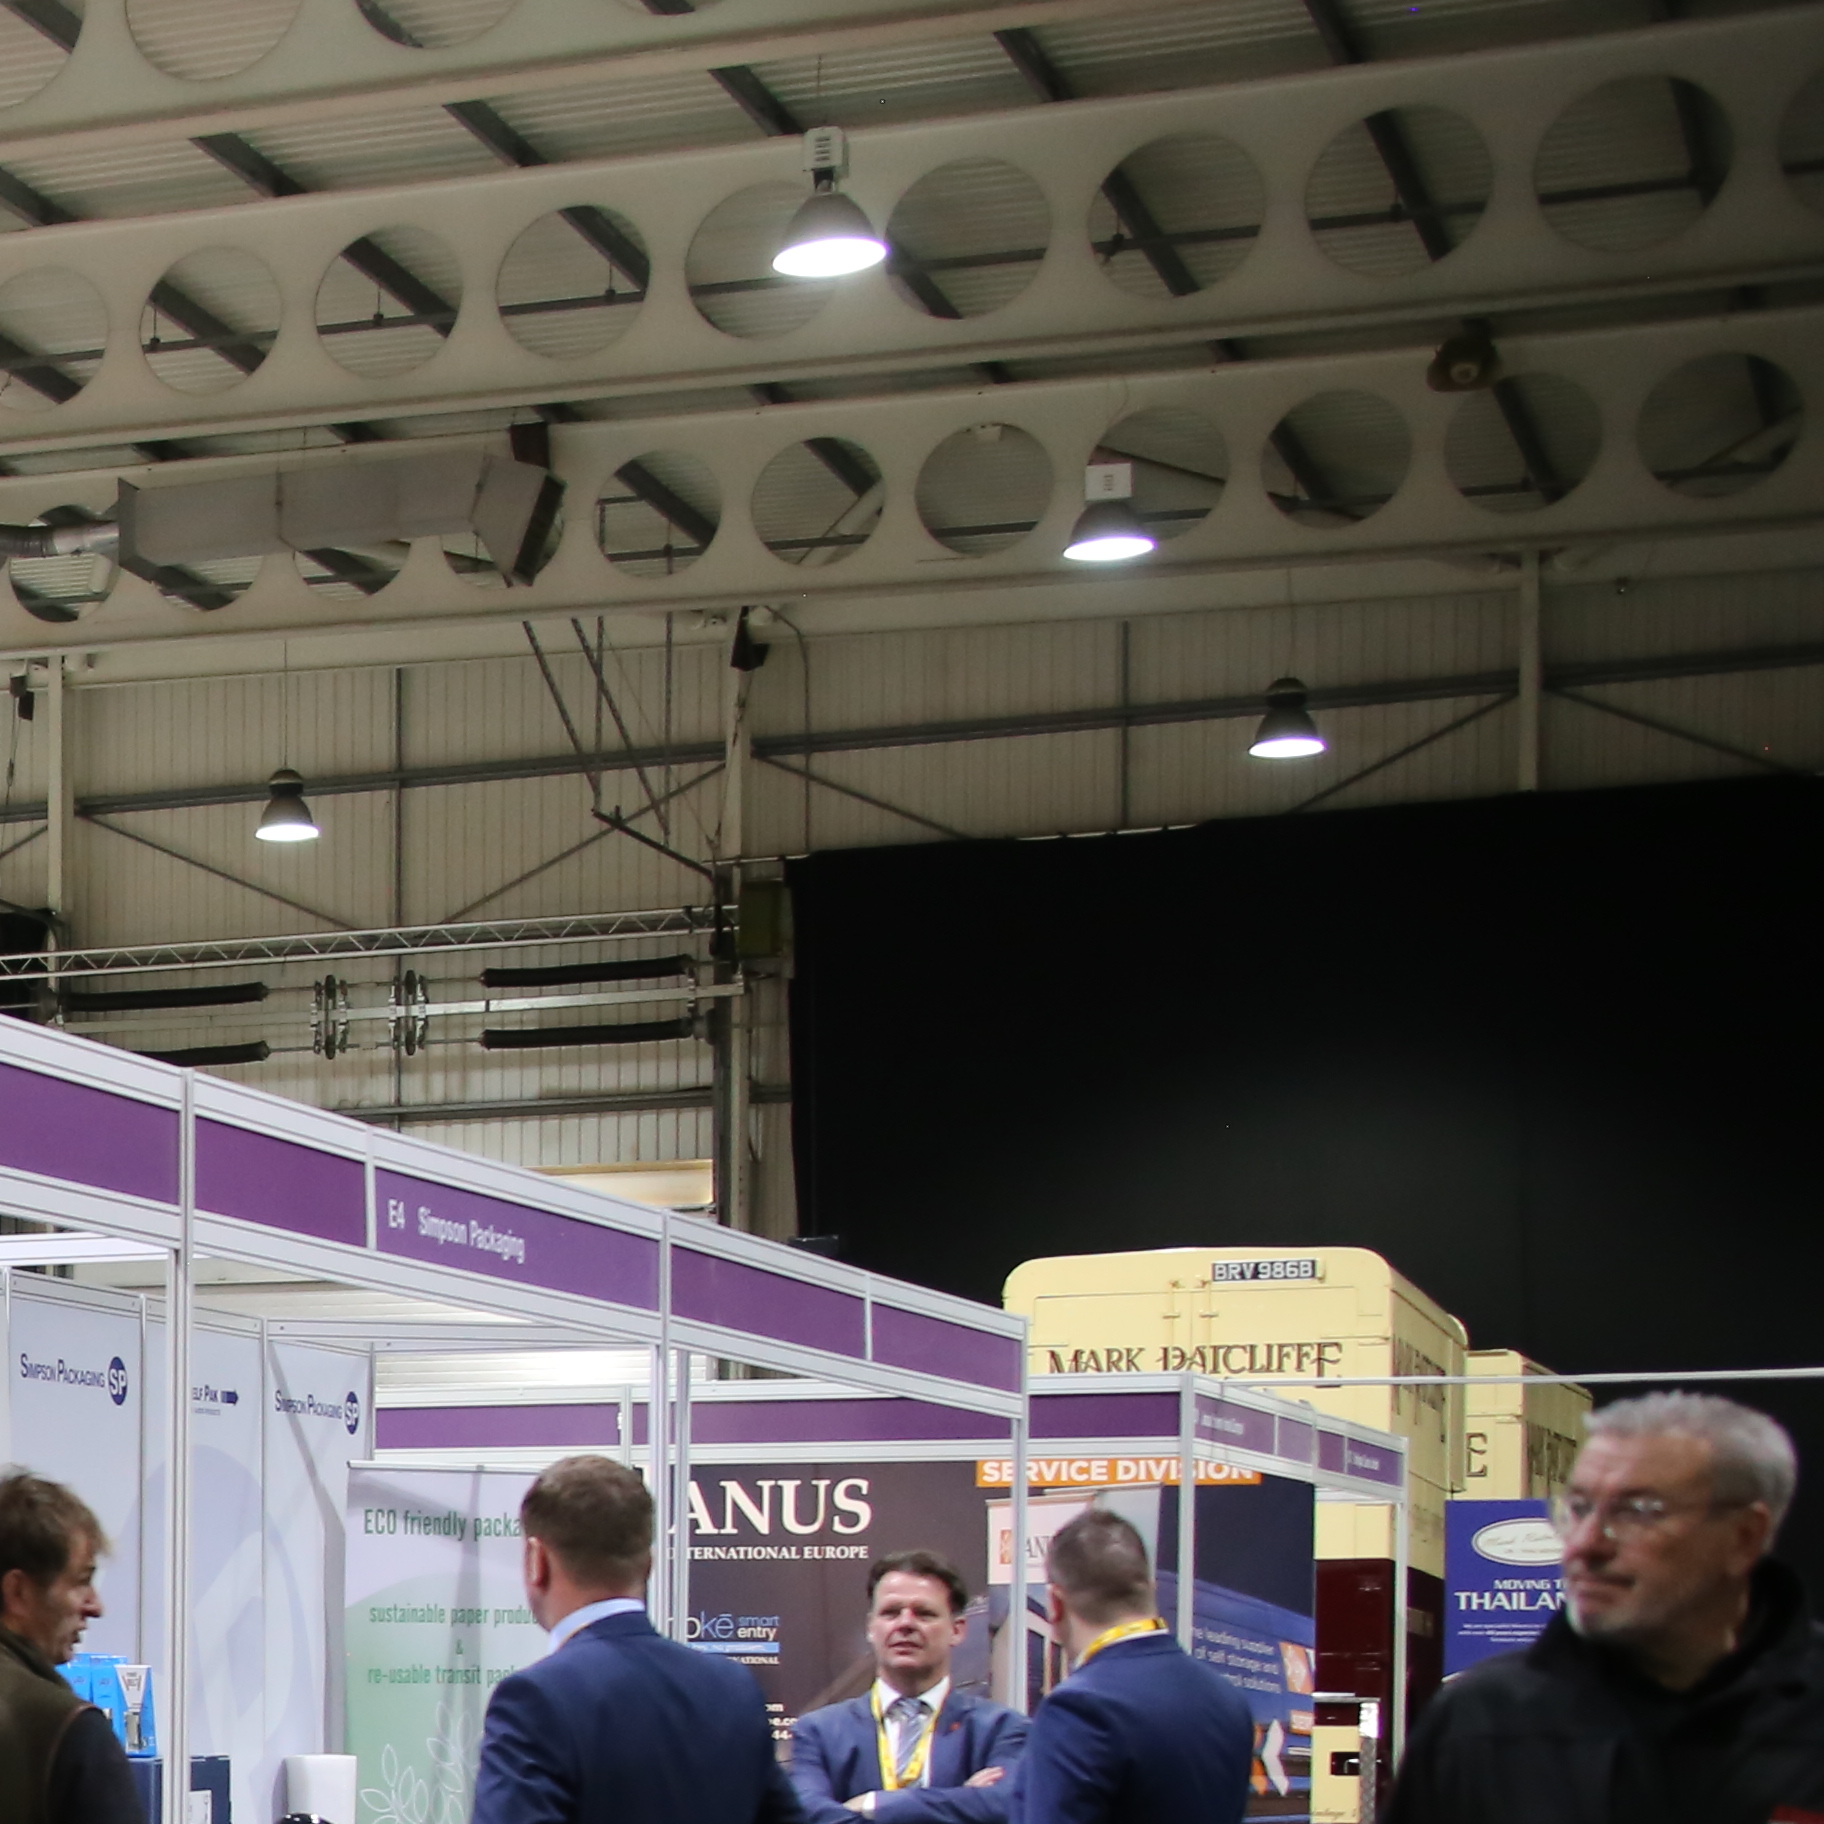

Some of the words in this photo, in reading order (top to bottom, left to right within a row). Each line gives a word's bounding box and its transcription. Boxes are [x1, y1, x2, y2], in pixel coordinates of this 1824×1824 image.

[388, 1198, 406, 1230] E4
[417, 1205, 468, 1246] Simpson
[468, 1218, 526, 1265] Packaging
[1213, 1262, 1255, 1281] BRV
[1257, 1260, 1314, 1280] 986B
[1047, 1346, 1146, 1376] MARK
[109, 1368, 128, 1396] SP
[192, 1387, 204, 1401] ELF
[1116, 1458, 1254, 1482] DIVIION
[668, 1478, 872, 1536] ANUS
[363, 1508, 397, 1536] ECO
[403, 1510, 467, 1543] friendly
[473, 1512, 524, 1543] packa
[687, 1545, 801, 1560] TERNATIONAL
[802, 1545, 869, 1560] EUROPE
[1493, 1579, 1551, 1590] MOVING
[1453, 1591, 1566, 1611] THAILA
[369, 1603, 446, 1624] sustainable
[450, 1607, 490, 1628] paper
[493, 1604, 537, 1629] produ
[737, 1626, 778, 1642] entry
[367, 1664, 432, 1685] re-usable
[435, 1665, 483, 1685] transit
